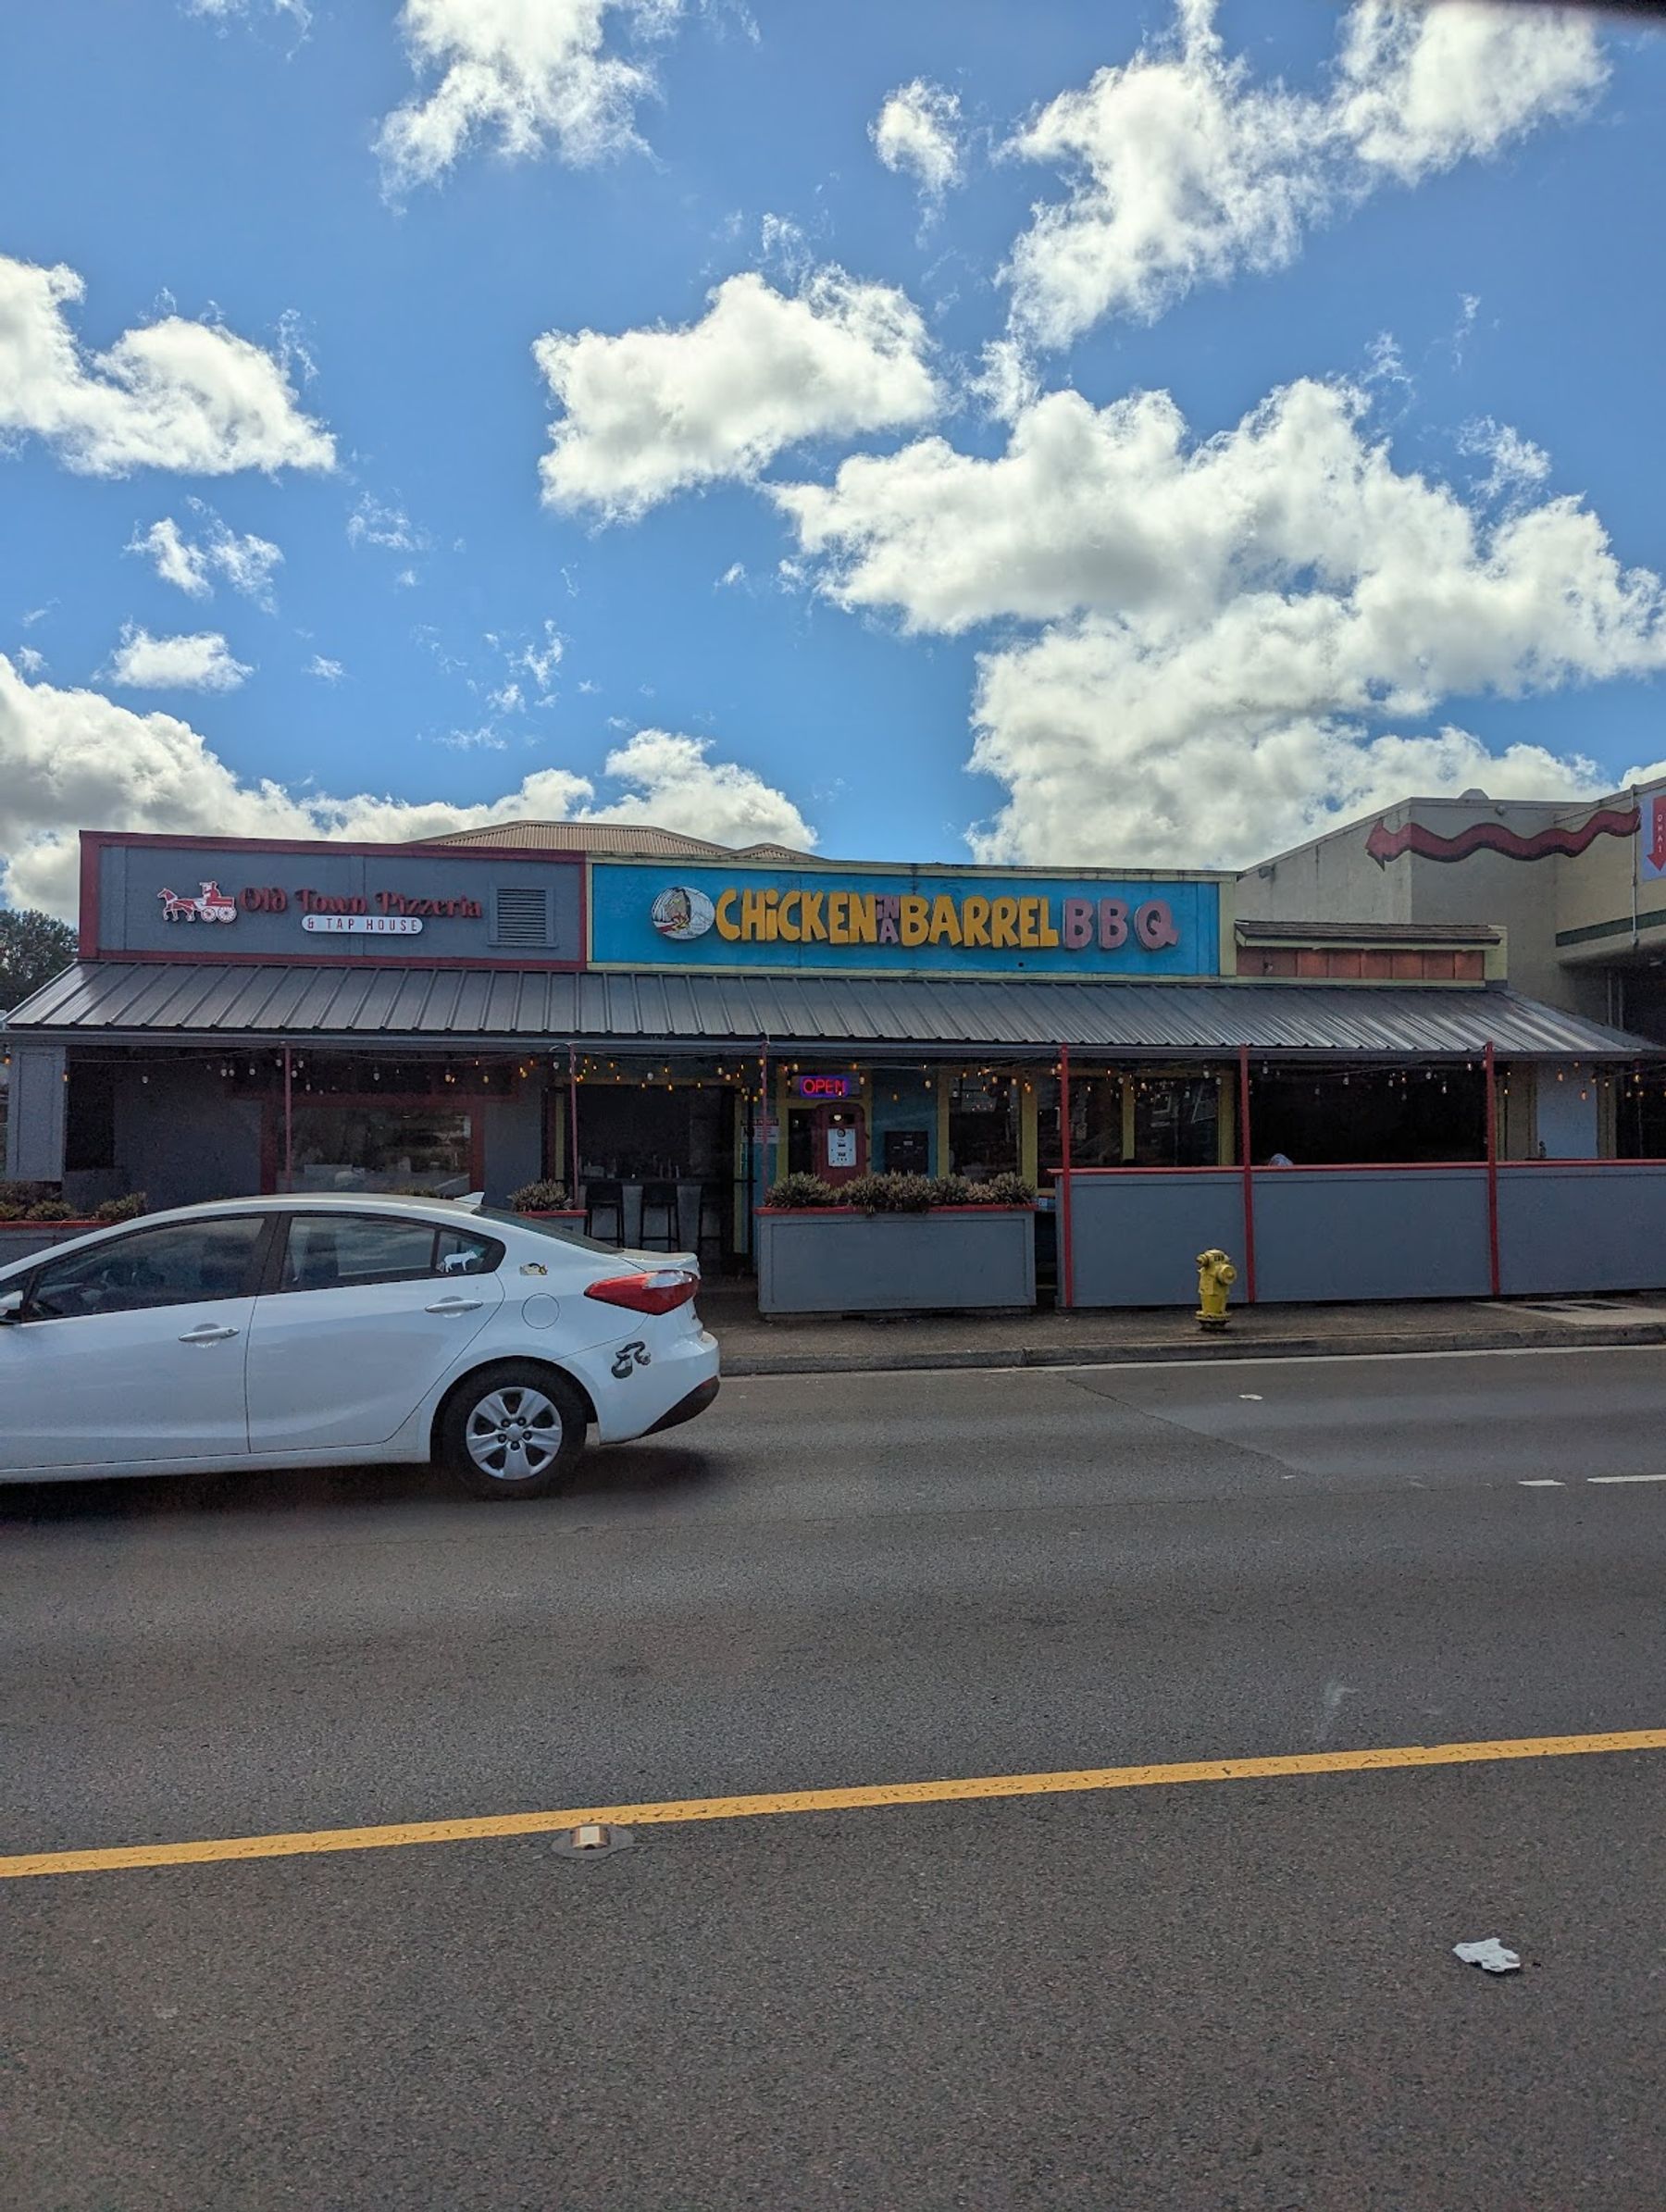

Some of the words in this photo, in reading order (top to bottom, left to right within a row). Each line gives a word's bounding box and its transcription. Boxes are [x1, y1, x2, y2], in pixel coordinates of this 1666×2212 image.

[239, 887, 288, 913] Old
[294, 889, 367, 914] Town
[375, 889, 483, 918] Pizzeria
[307, 917, 315, 930] &
[326, 917, 355, 930] TAP
[366, 918, 418, 932] HOUSE
[880, 919, 900, 944] A
[900, 894, 1060, 948] BARREL
[802, 1078, 846, 1095] OPEN
